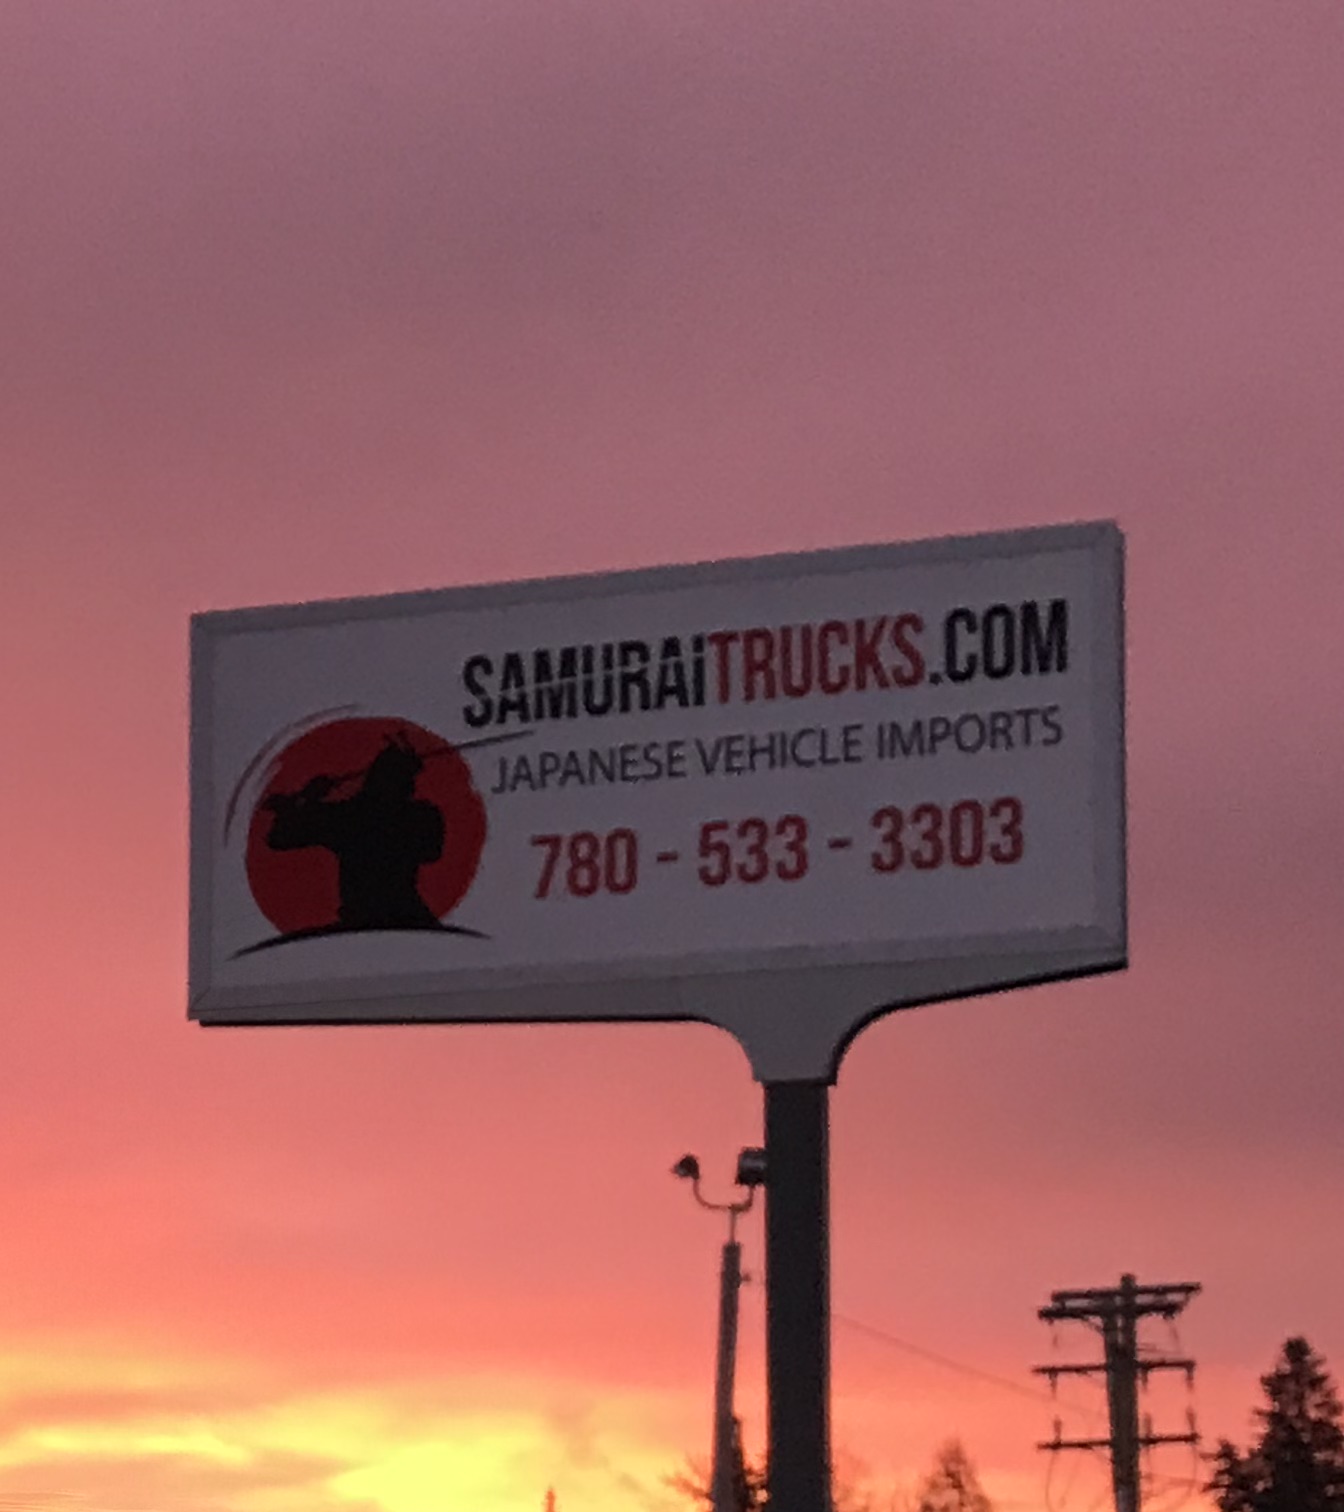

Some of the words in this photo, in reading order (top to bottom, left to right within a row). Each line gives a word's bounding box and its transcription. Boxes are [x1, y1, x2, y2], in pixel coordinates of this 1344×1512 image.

[491, 740, 687, 794] JAPANESE
[694, 723, 864, 776] VEHICLE
[876, 704, 1063, 760] IMPORTS
[529, 827, 638, 900] 780
[697, 814, 809, 888] 533
[870, 796, 1024, 874] 3303
